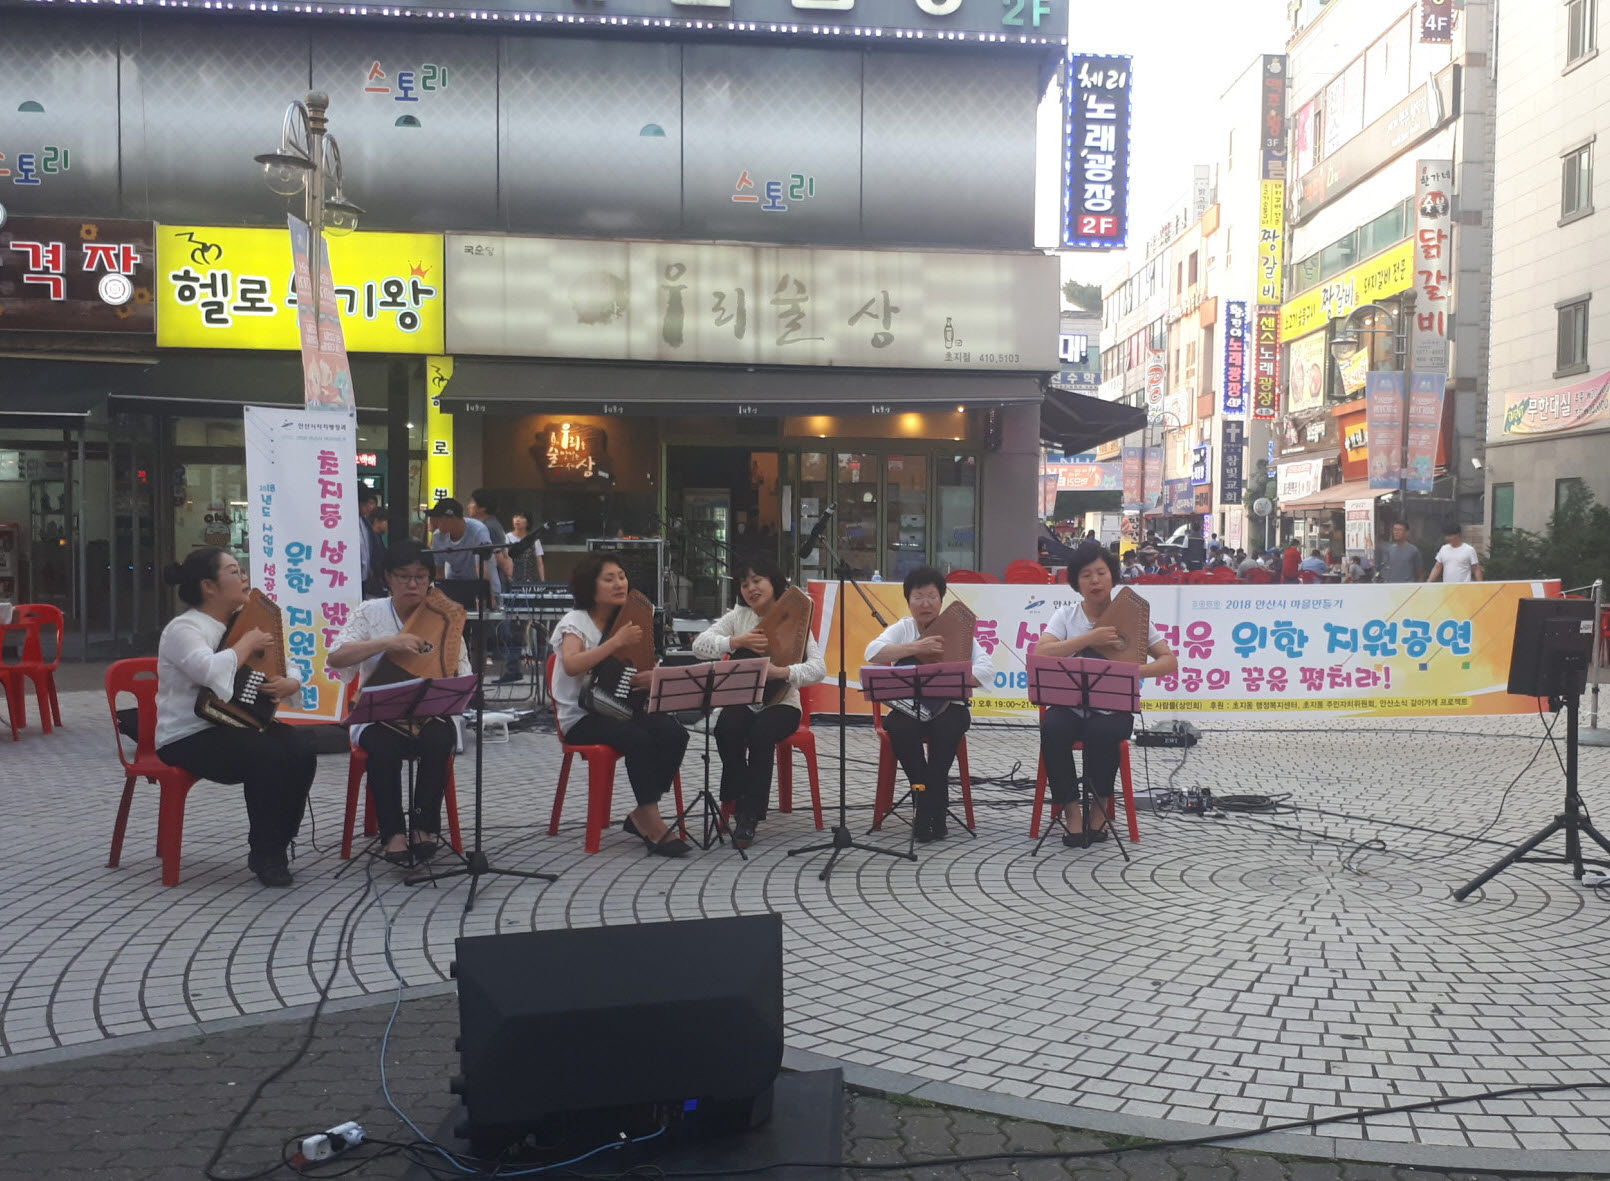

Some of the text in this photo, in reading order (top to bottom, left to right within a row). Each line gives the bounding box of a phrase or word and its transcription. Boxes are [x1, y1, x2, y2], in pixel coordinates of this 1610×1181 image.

[1424, 14, 1448, 31] 4F
[364, 60, 449, 102] 스토리
[1266, 138, 1279, 147] 3F
[731, 171, 816, 212] 스토리
[1082, 217, 1114, 235] 2F
[1418, 228, 1448, 337] 닭갈비
[1260, 317, 1275, 344] 센스
[1258, 348, 1274, 406] 노래광장
[1527, 391, 1572, 422] 무한대실
[317, 449, 343, 529] 초지동
[1224, 455, 1239, 503] 참빛교회
[284, 541, 314, 594] 위한
[320, 539, 348, 588] 상가
[1225, 599, 1251, 610] 2018
[1255, 599, 1287, 610] 안산시
[1231, 619, 1309, 659] 위한
[1323, 617, 1473, 659] 지원공연
[1241, 665, 1289, 692] 꿈을
[1210, 700, 1225, 710] 후원
